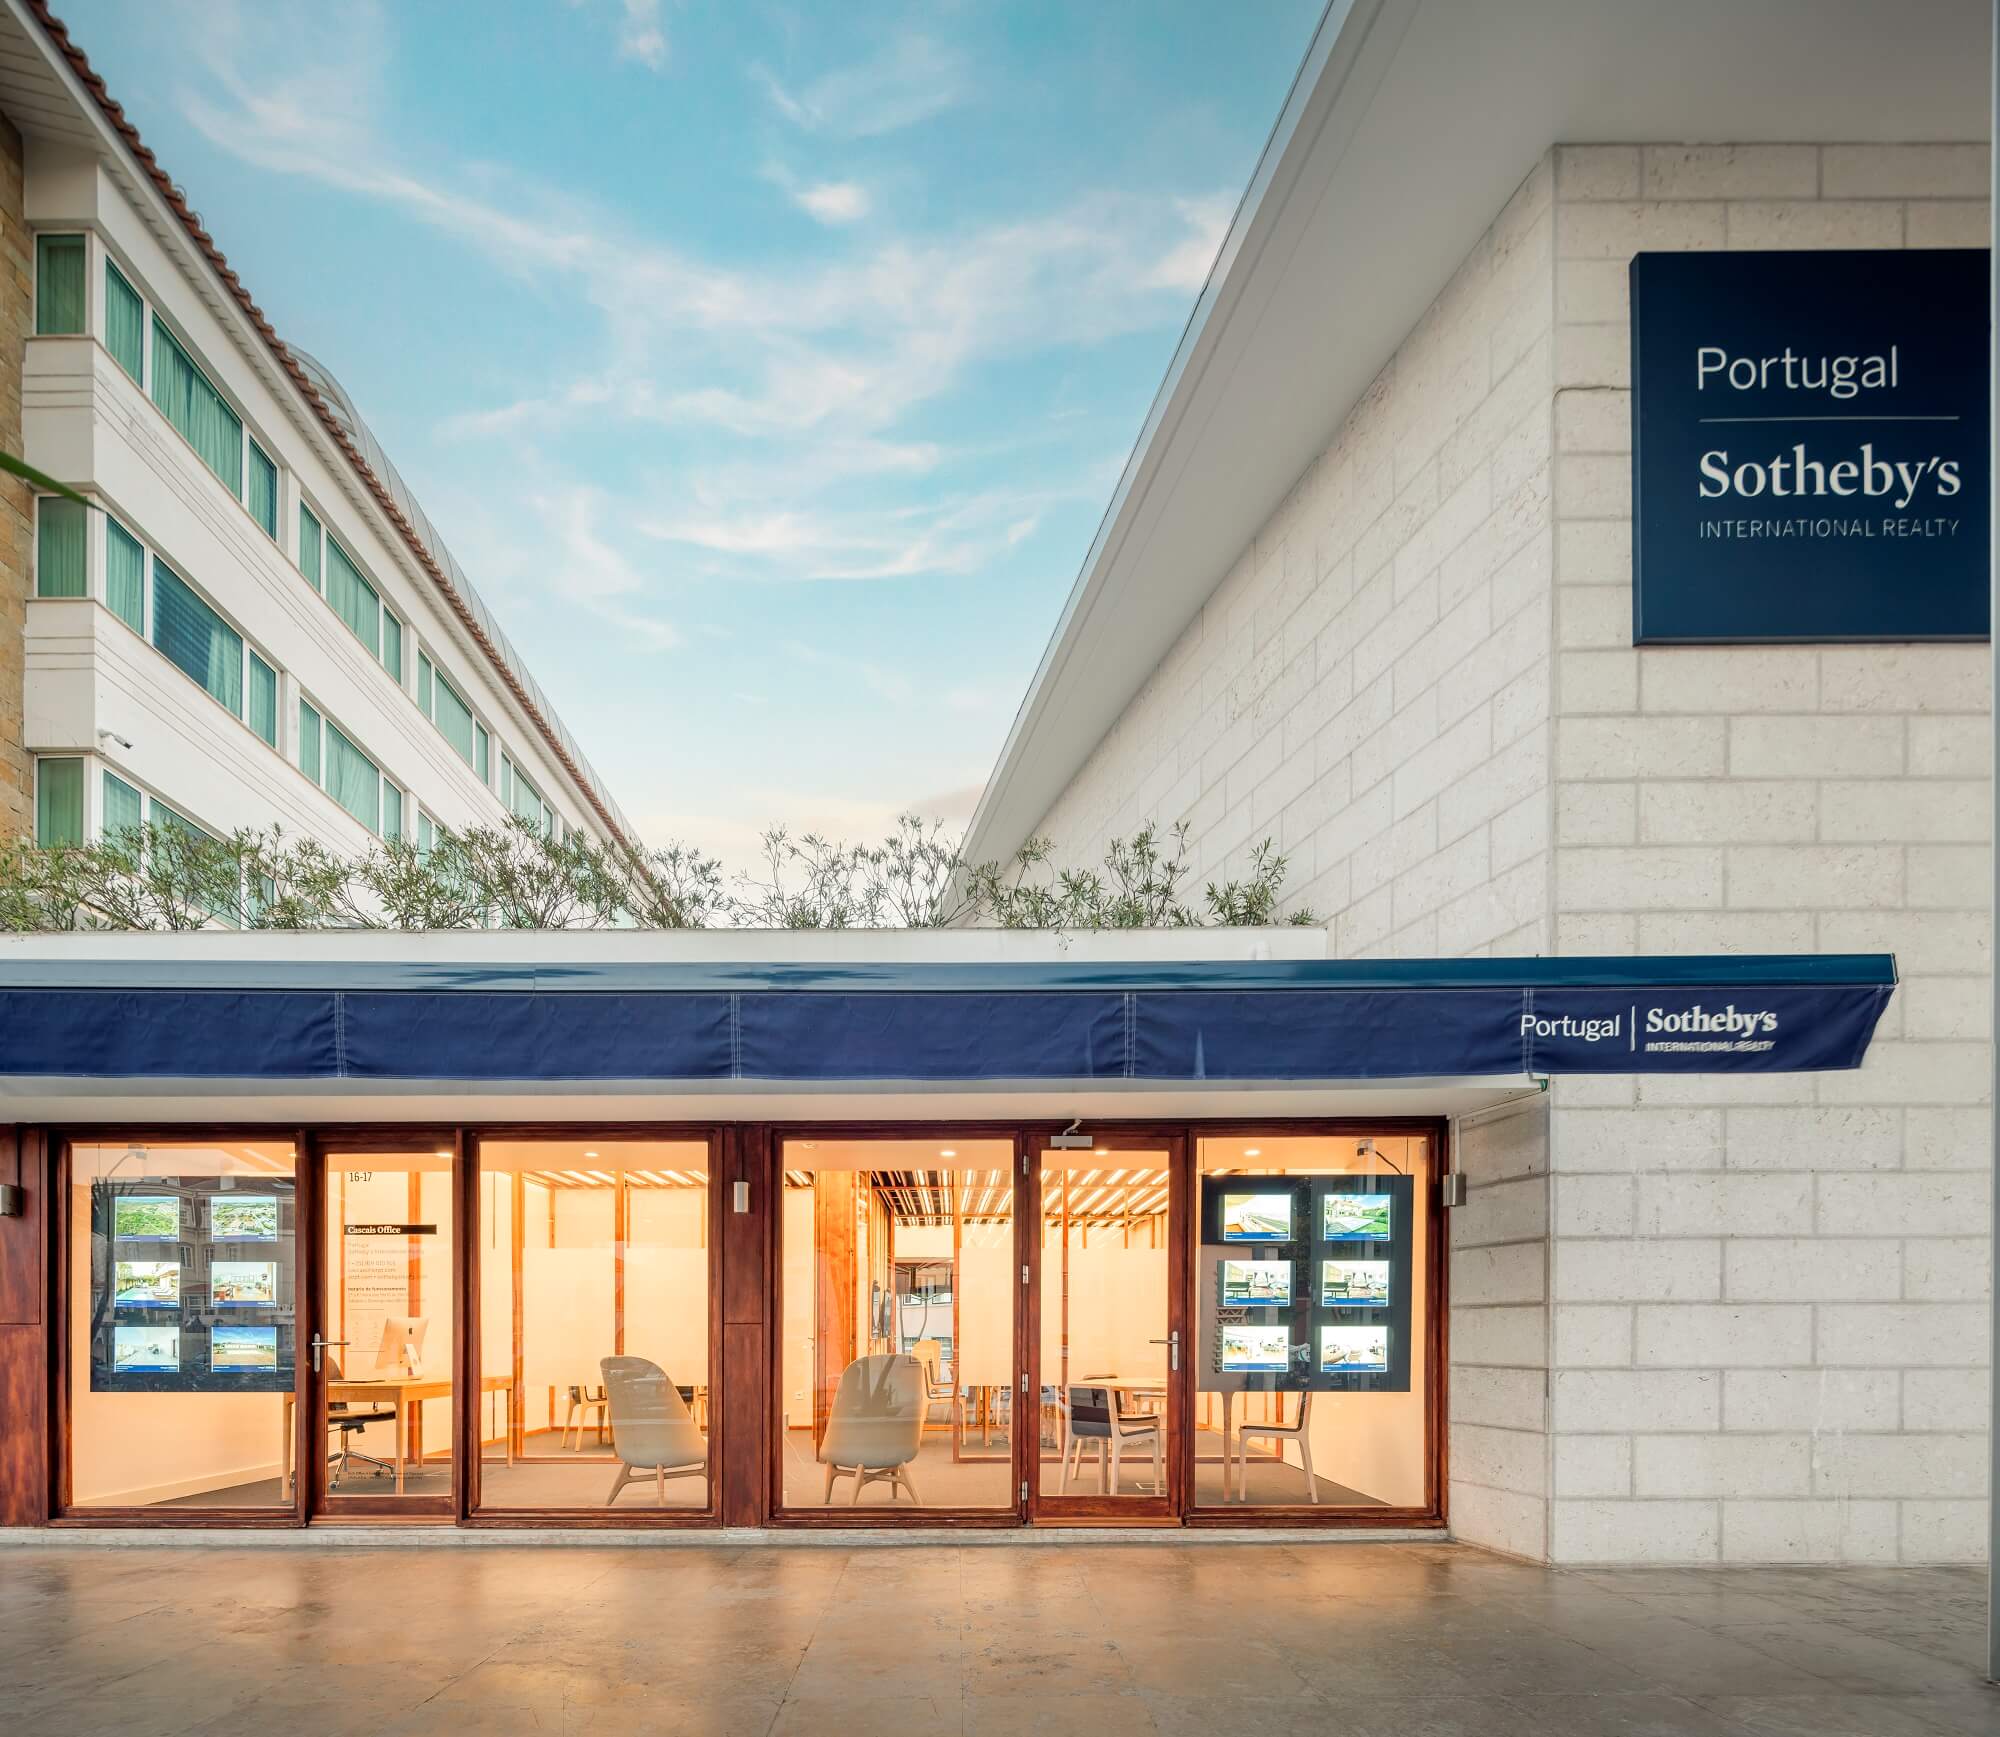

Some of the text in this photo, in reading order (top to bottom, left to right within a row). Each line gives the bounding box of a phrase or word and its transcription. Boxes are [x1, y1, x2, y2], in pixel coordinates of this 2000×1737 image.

[1697, 345, 1898, 399] Portugal
[1699, 443, 1961, 509] Sotheby's
[1700, 518, 1960, 539] INTERNATIONAL REALTY
[1520, 1004, 1778, 1042] Portugal Sotheby's
[349, 1171, 372, 1182] 16-17
[347, 1225, 401, 1235] Cascais Office
